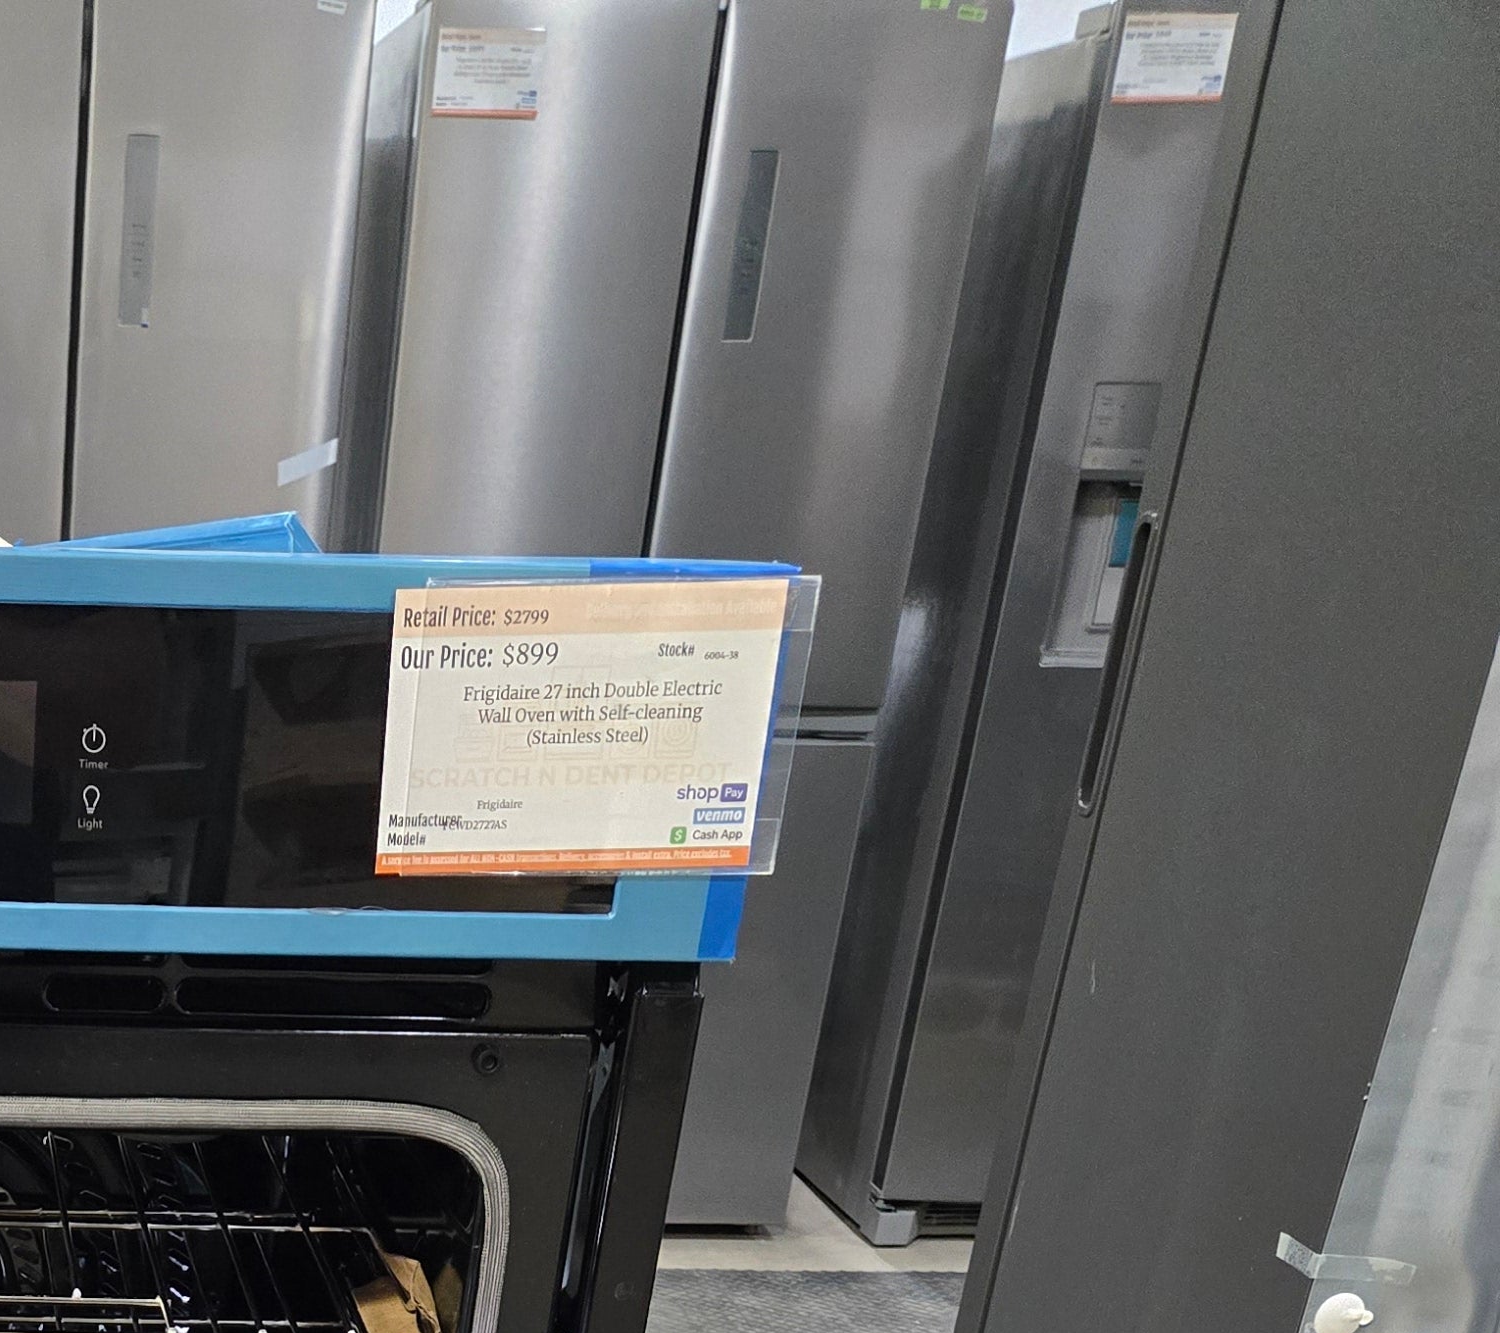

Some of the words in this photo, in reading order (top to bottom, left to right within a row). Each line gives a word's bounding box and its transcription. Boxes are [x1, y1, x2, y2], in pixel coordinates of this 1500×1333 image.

[403, 605, 448, 628] Retail
[452, 604, 496, 627] Price:
[503, 608, 549, 625] $2799
[401, 645, 434, 669] Our
[440, 642, 493, 669] Price:
[502, 642, 559, 667] $899
[658, 641, 695, 657] Stock#
[703, 650, 739, 660] 6004-38
[463, 684, 540, 705] Frigidaire
[543, 683, 562, 699] 27
[565, 682, 600, 699] inch
[604, 681, 659, 698] Double
[662, 679, 722, 697] Electric
[478, 706, 511, 724] Wall
[515, 706, 555, 723] Oven
[560, 705, 595, 722] with
[599, 703, 703, 723] Self-cleaning
[526, 727, 601, 748] (Stainless
[605, 726, 649, 746] Steel)
[79, 758, 108, 770] Timer
[410, 765, 530, 789] SCRATCH
[539, 766, 556, 787] N
[565, 764, 637, 786] DENT
[643, 761, 732, 784] DEPOT
[676, 784, 719, 803] shop
[724, 787, 744, 799] Pay
[477, 799, 523, 811] Frigidaire
[77, 817, 103, 831] Light
[389, 813, 462, 828] Manufacturer
[696, 809, 742, 822] venmo
[387, 831, 426, 846] Model#
[692, 829, 719, 840] Cash
[720, 829, 743, 841] App
